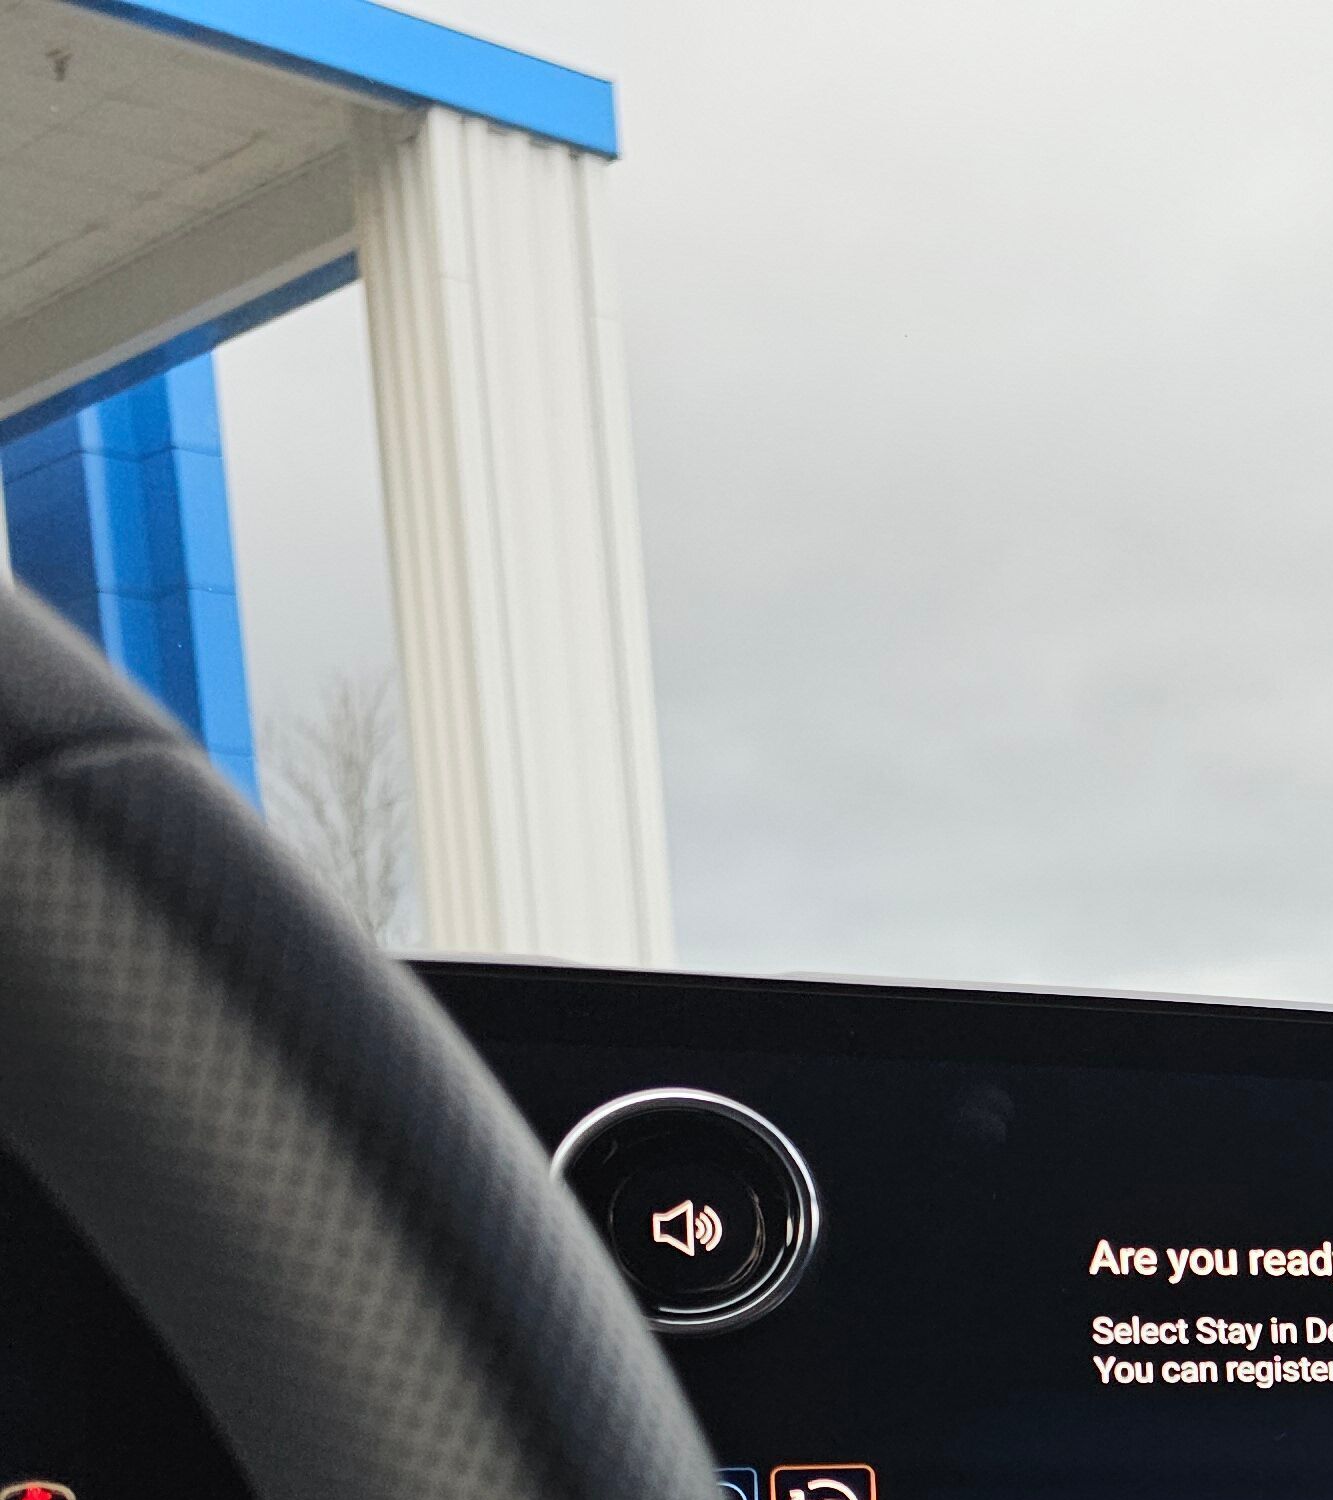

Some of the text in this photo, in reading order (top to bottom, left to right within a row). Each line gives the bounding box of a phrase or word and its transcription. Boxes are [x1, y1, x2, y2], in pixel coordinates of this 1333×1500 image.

[1089, 1239, 1157, 1276] Are
[1166, 1247, 1239, 1284] you
[1092, 1315, 1189, 1345] Select
[1195, 1316, 1263, 1350] Stay
[1270, 1316, 1298, 1345] in
[1093, 1355, 1154, 1385] You
[1161, 1360, 1219, 1384] can
